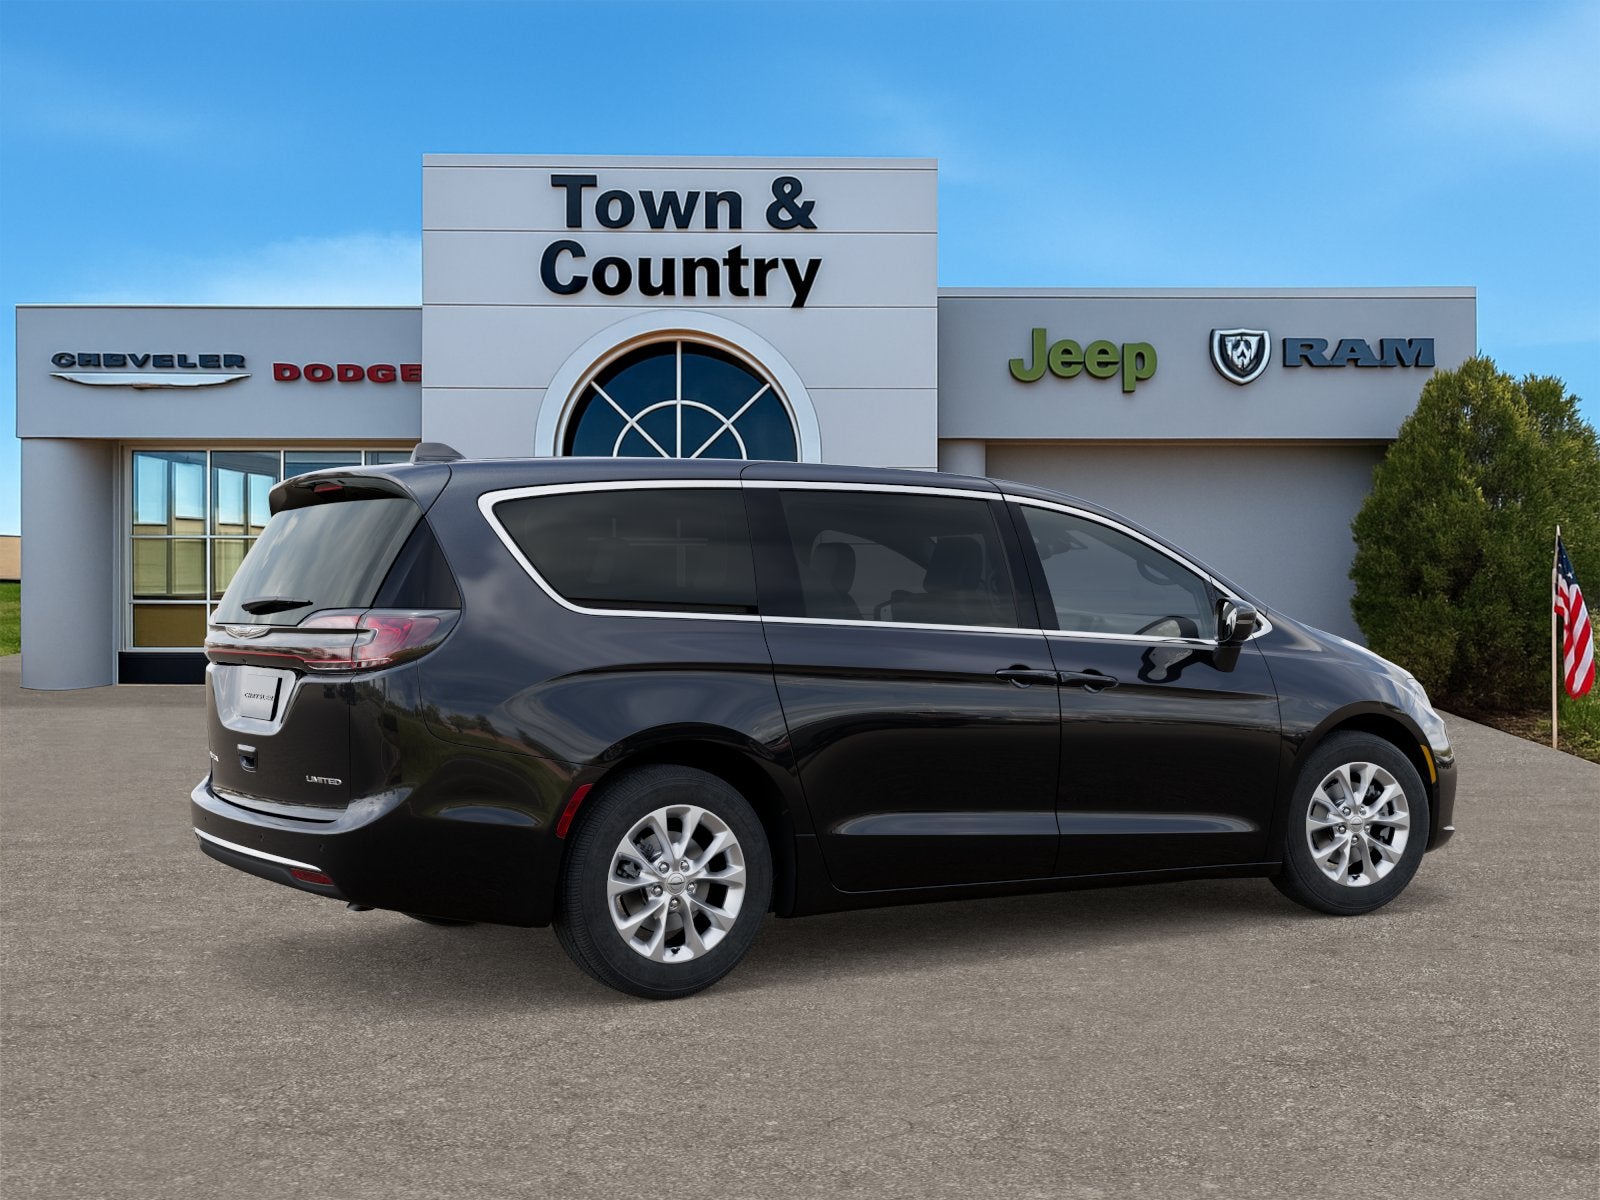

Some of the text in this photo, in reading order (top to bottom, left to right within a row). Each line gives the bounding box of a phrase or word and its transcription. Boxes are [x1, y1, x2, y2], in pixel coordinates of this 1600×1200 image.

[551, 174, 818, 230] Town &
[540, 239, 822, 308] Country
[273, 363, 422, 383] DODGE
[1008, 328, 1157, 393] Jeep
[1282, 337, 1435, 368] RAM
[305, 775, 342, 786] LIMITED
